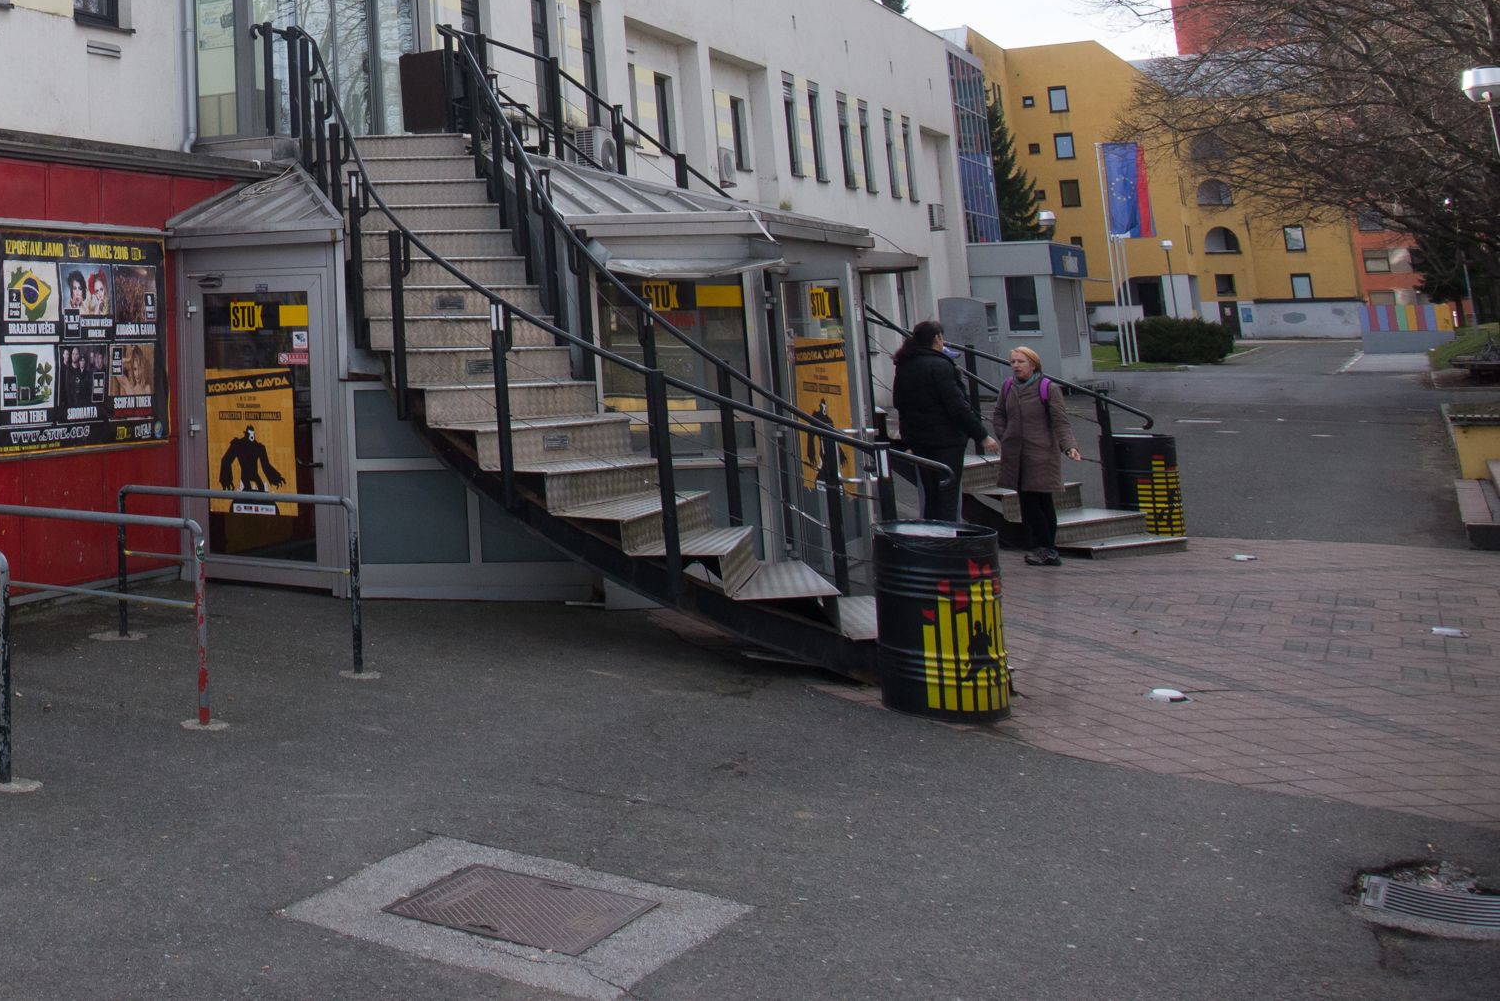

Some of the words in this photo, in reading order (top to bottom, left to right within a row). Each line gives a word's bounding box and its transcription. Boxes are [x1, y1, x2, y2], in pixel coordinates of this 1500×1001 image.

[5, 240, 64, 257] IZPOSTAVLJAMO
[89, 244, 112, 259] MAREC
[113, 246, 129, 260] 2016
[8, 323, 37, 334] BRAZILSKI
[38, 321, 56, 334] VEČER
[208, 380, 253, 393] KOROŠKA
[255, 376, 290, 388] GAVDA
[10, 411, 28, 424] IRSKI
[29, 410, 47, 423] TEDEN
